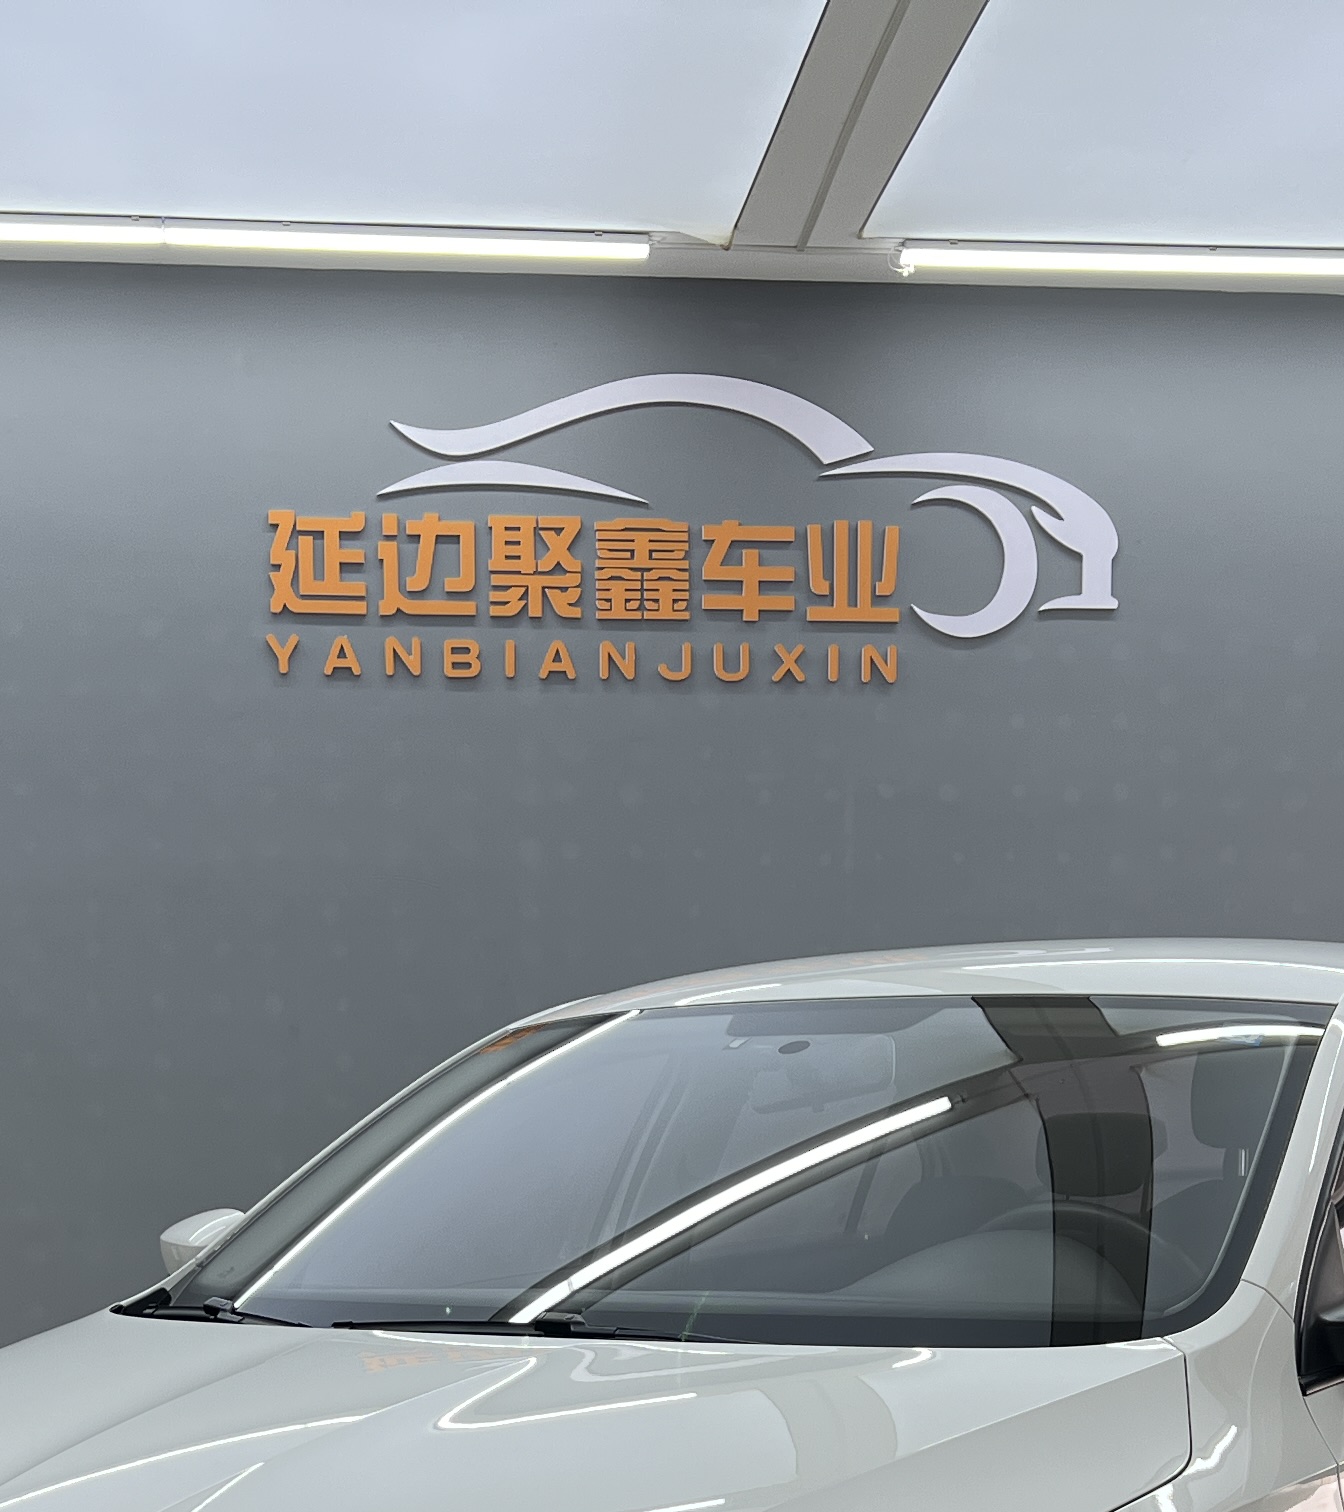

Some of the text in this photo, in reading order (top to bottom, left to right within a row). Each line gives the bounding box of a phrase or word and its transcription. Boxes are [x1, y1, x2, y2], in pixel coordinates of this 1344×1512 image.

[267, 509, 900, 623] 延边聚鑫车业
[266, 633, 899, 684] YANBIANJUXIN
